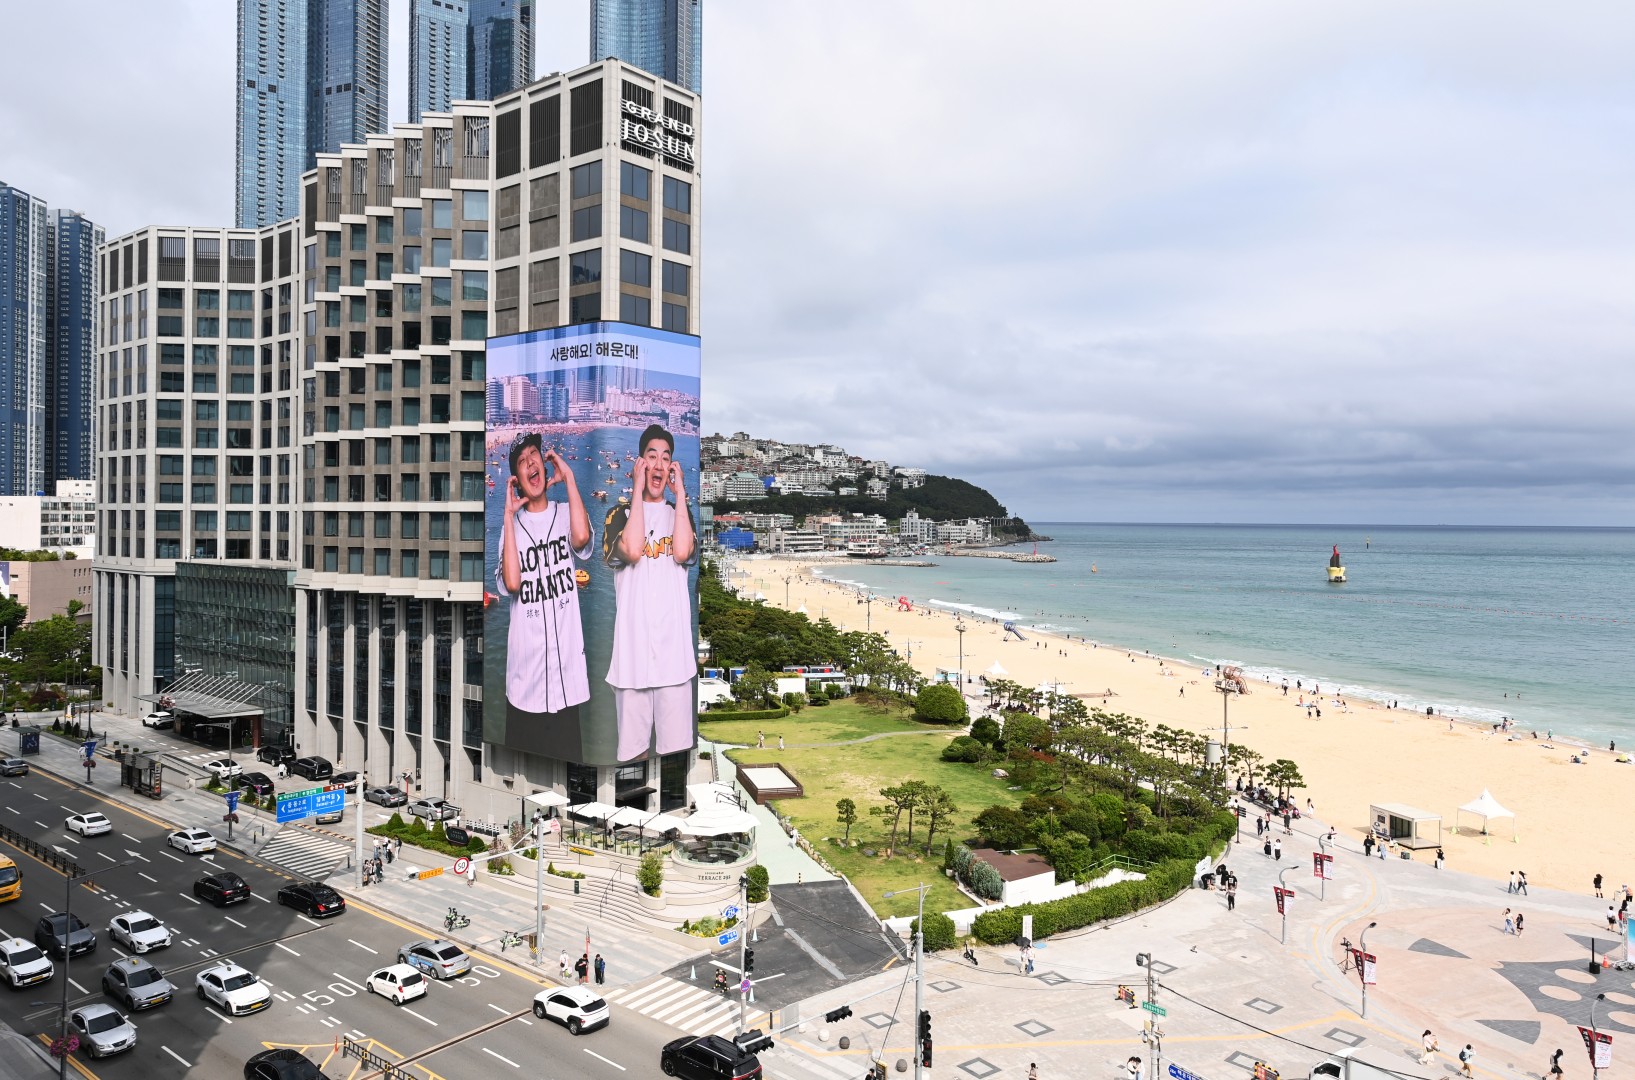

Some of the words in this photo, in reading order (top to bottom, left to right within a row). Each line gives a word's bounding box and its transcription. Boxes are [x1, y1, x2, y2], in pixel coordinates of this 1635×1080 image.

[626, 100, 693, 136] GRAND
[621, 118, 695, 161] JOSUN
[550, 343, 592, 362] 사랑해요!
[595, 342, 639, 360] 해운대!
[520, 567, 574, 604] GIANTS
[457, 861, 466, 870] 50
[455, 965, 501, 987] 50
[302, 982, 357, 1006] 50
